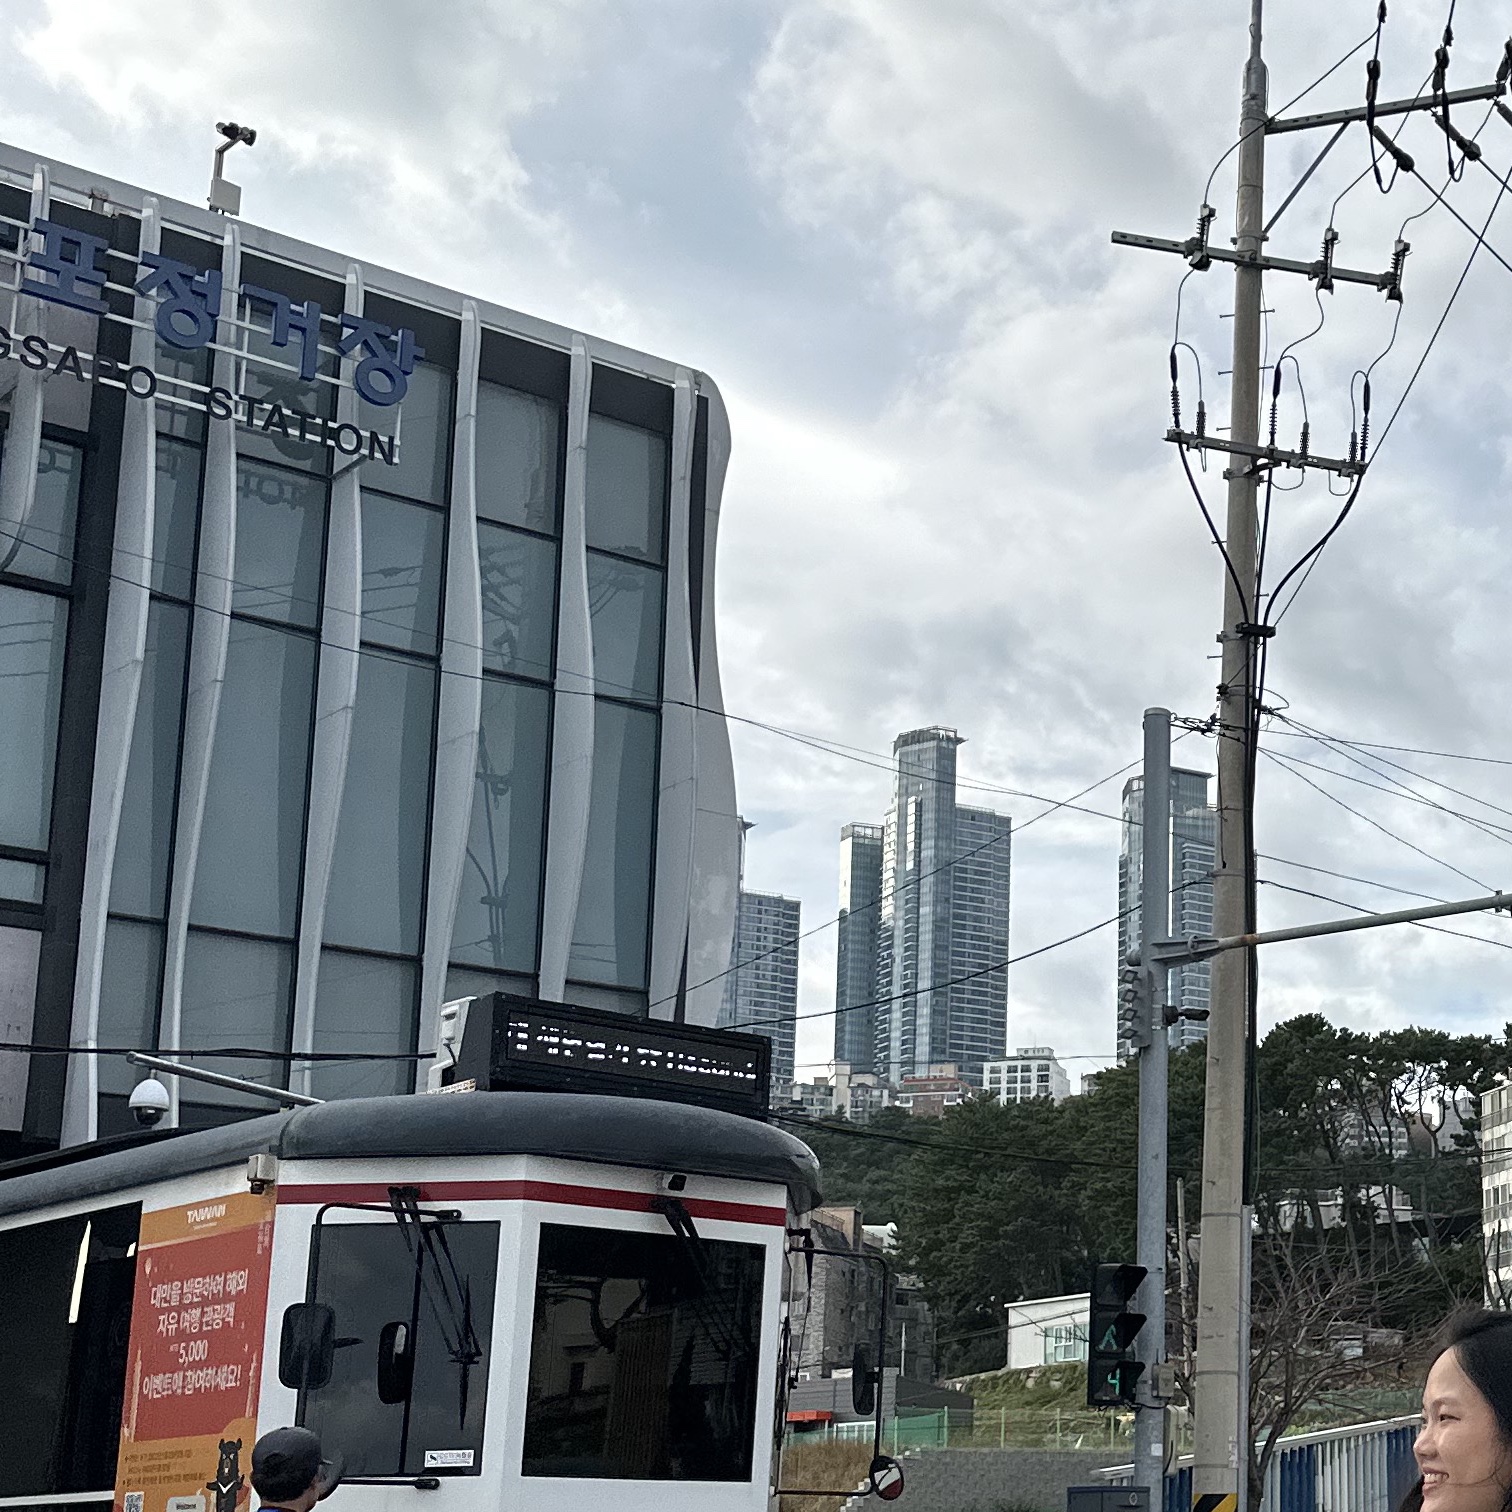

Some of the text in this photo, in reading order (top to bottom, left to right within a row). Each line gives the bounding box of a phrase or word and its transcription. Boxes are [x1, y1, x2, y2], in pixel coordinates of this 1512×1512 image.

[20, 217, 426, 407] 포정거장
[205, 387, 396, 466] STATION
[187, 1204, 227, 1224] TAIWAN
[151, 1281, 181, 1308] 대만을
[157, 1311, 178, 1337] 자유
[178, 1340, 208, 1368] 5,000
